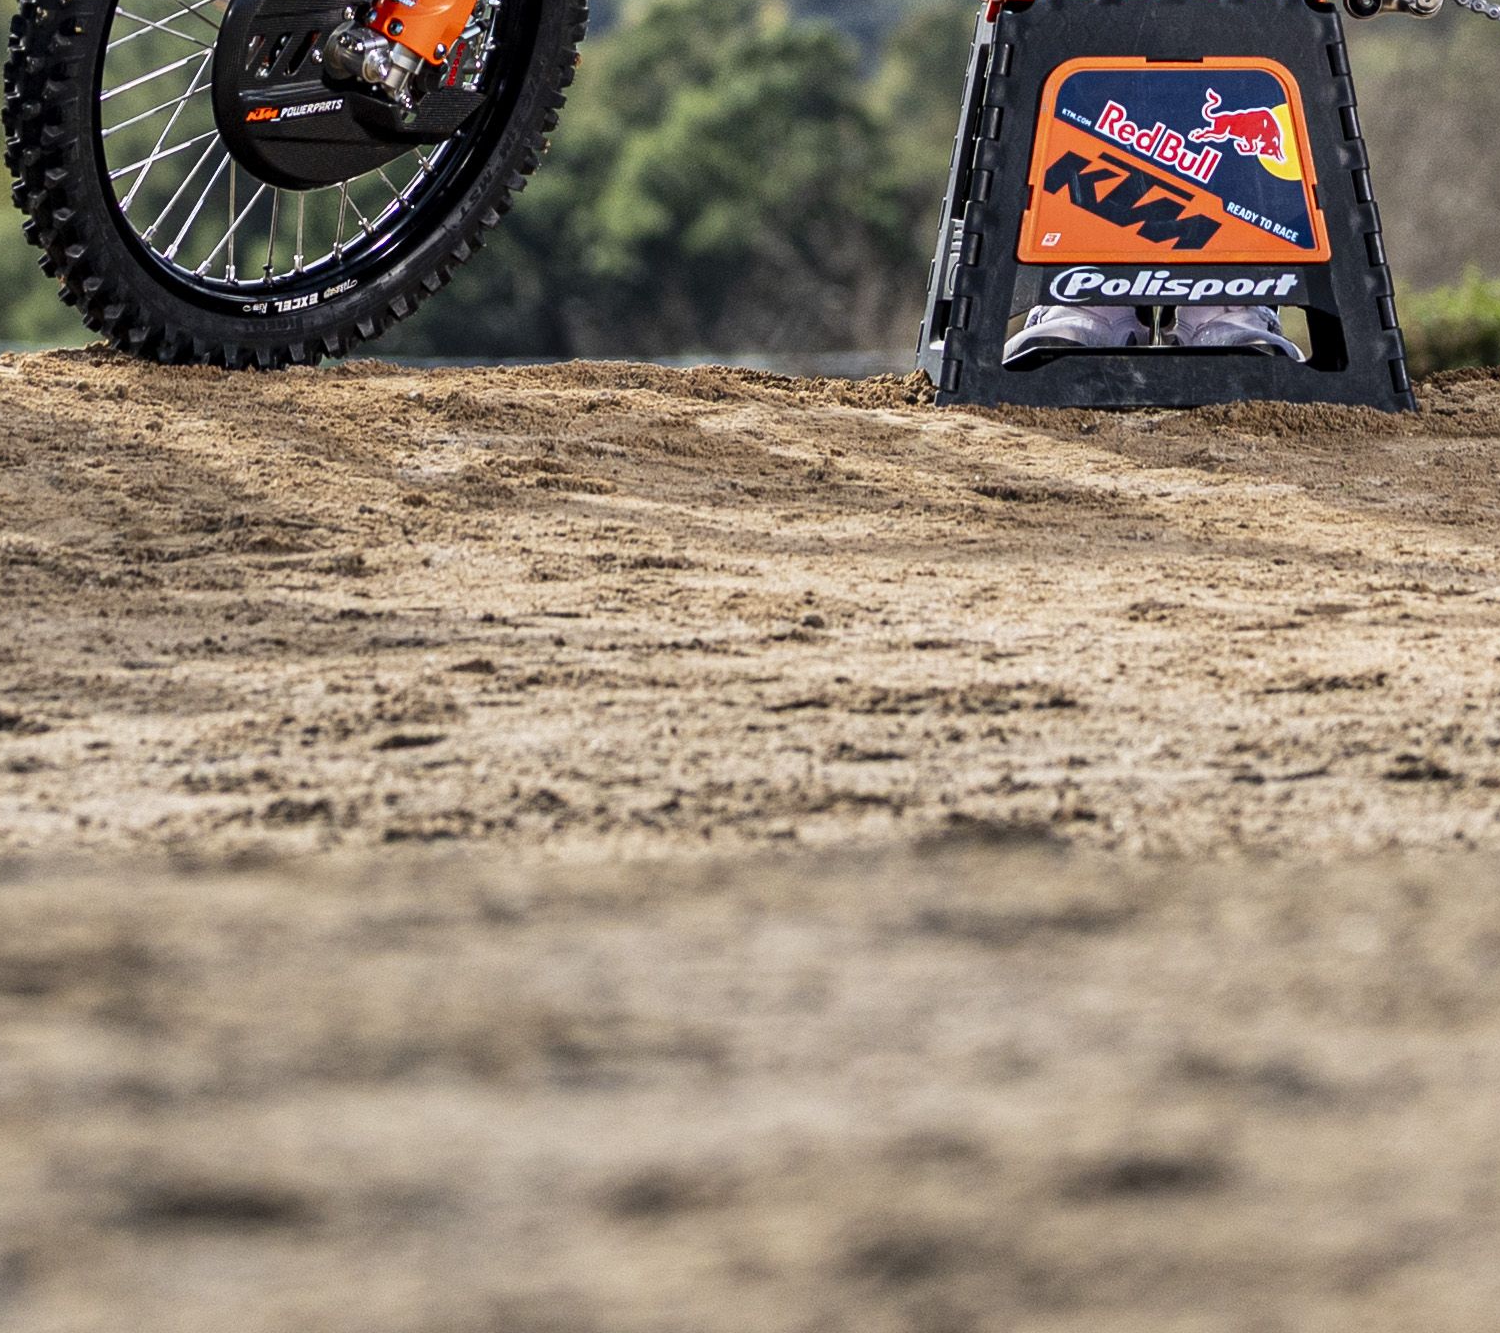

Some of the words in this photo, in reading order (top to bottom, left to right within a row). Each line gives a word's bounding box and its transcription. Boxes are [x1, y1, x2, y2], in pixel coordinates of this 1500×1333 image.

[1061, 108, 1092, 128] KTM.COM
[1095, 100, 1166, 156] Red
[1153, 129, 1222, 184] Bull
[1044, 150, 1222, 250] KTM
[1226, 201, 1259, 224] READY
[1260, 215, 1273, 230] TO
[1272, 223, 1299, 242] RACE
[1062, 270, 1298, 300] Polisport
[274, 293, 319, 313] EXCEL
